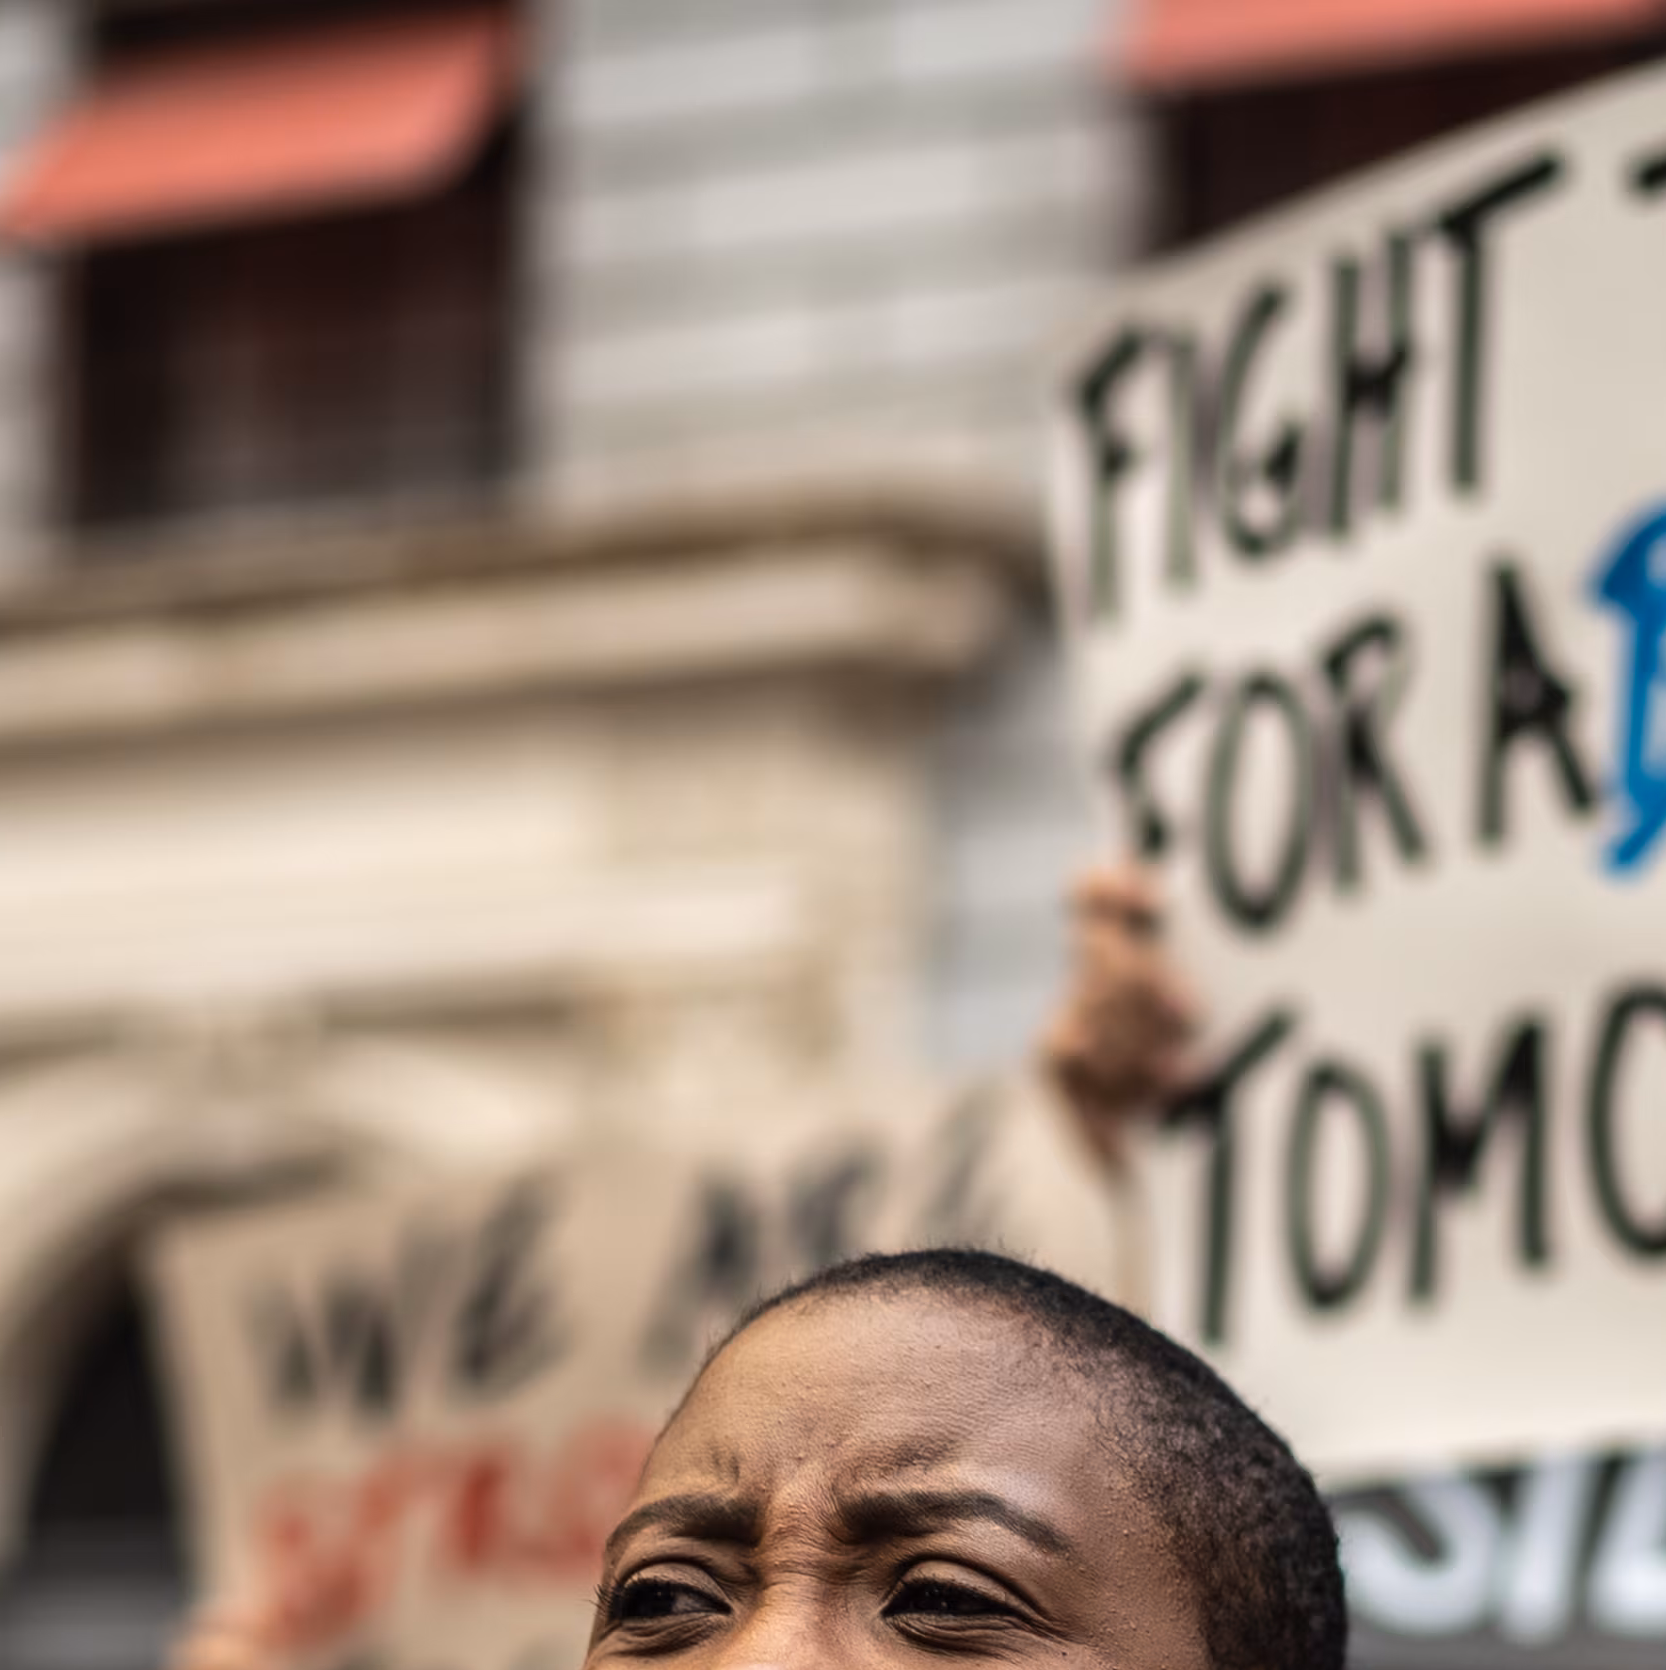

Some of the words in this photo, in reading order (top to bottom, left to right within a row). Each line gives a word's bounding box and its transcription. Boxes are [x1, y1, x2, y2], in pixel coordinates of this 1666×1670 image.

[1071, 153, 1565, 622] FIGHT
[1108, 612, 1430, 932] FOR
[1478, 555, 1595, 850] A
